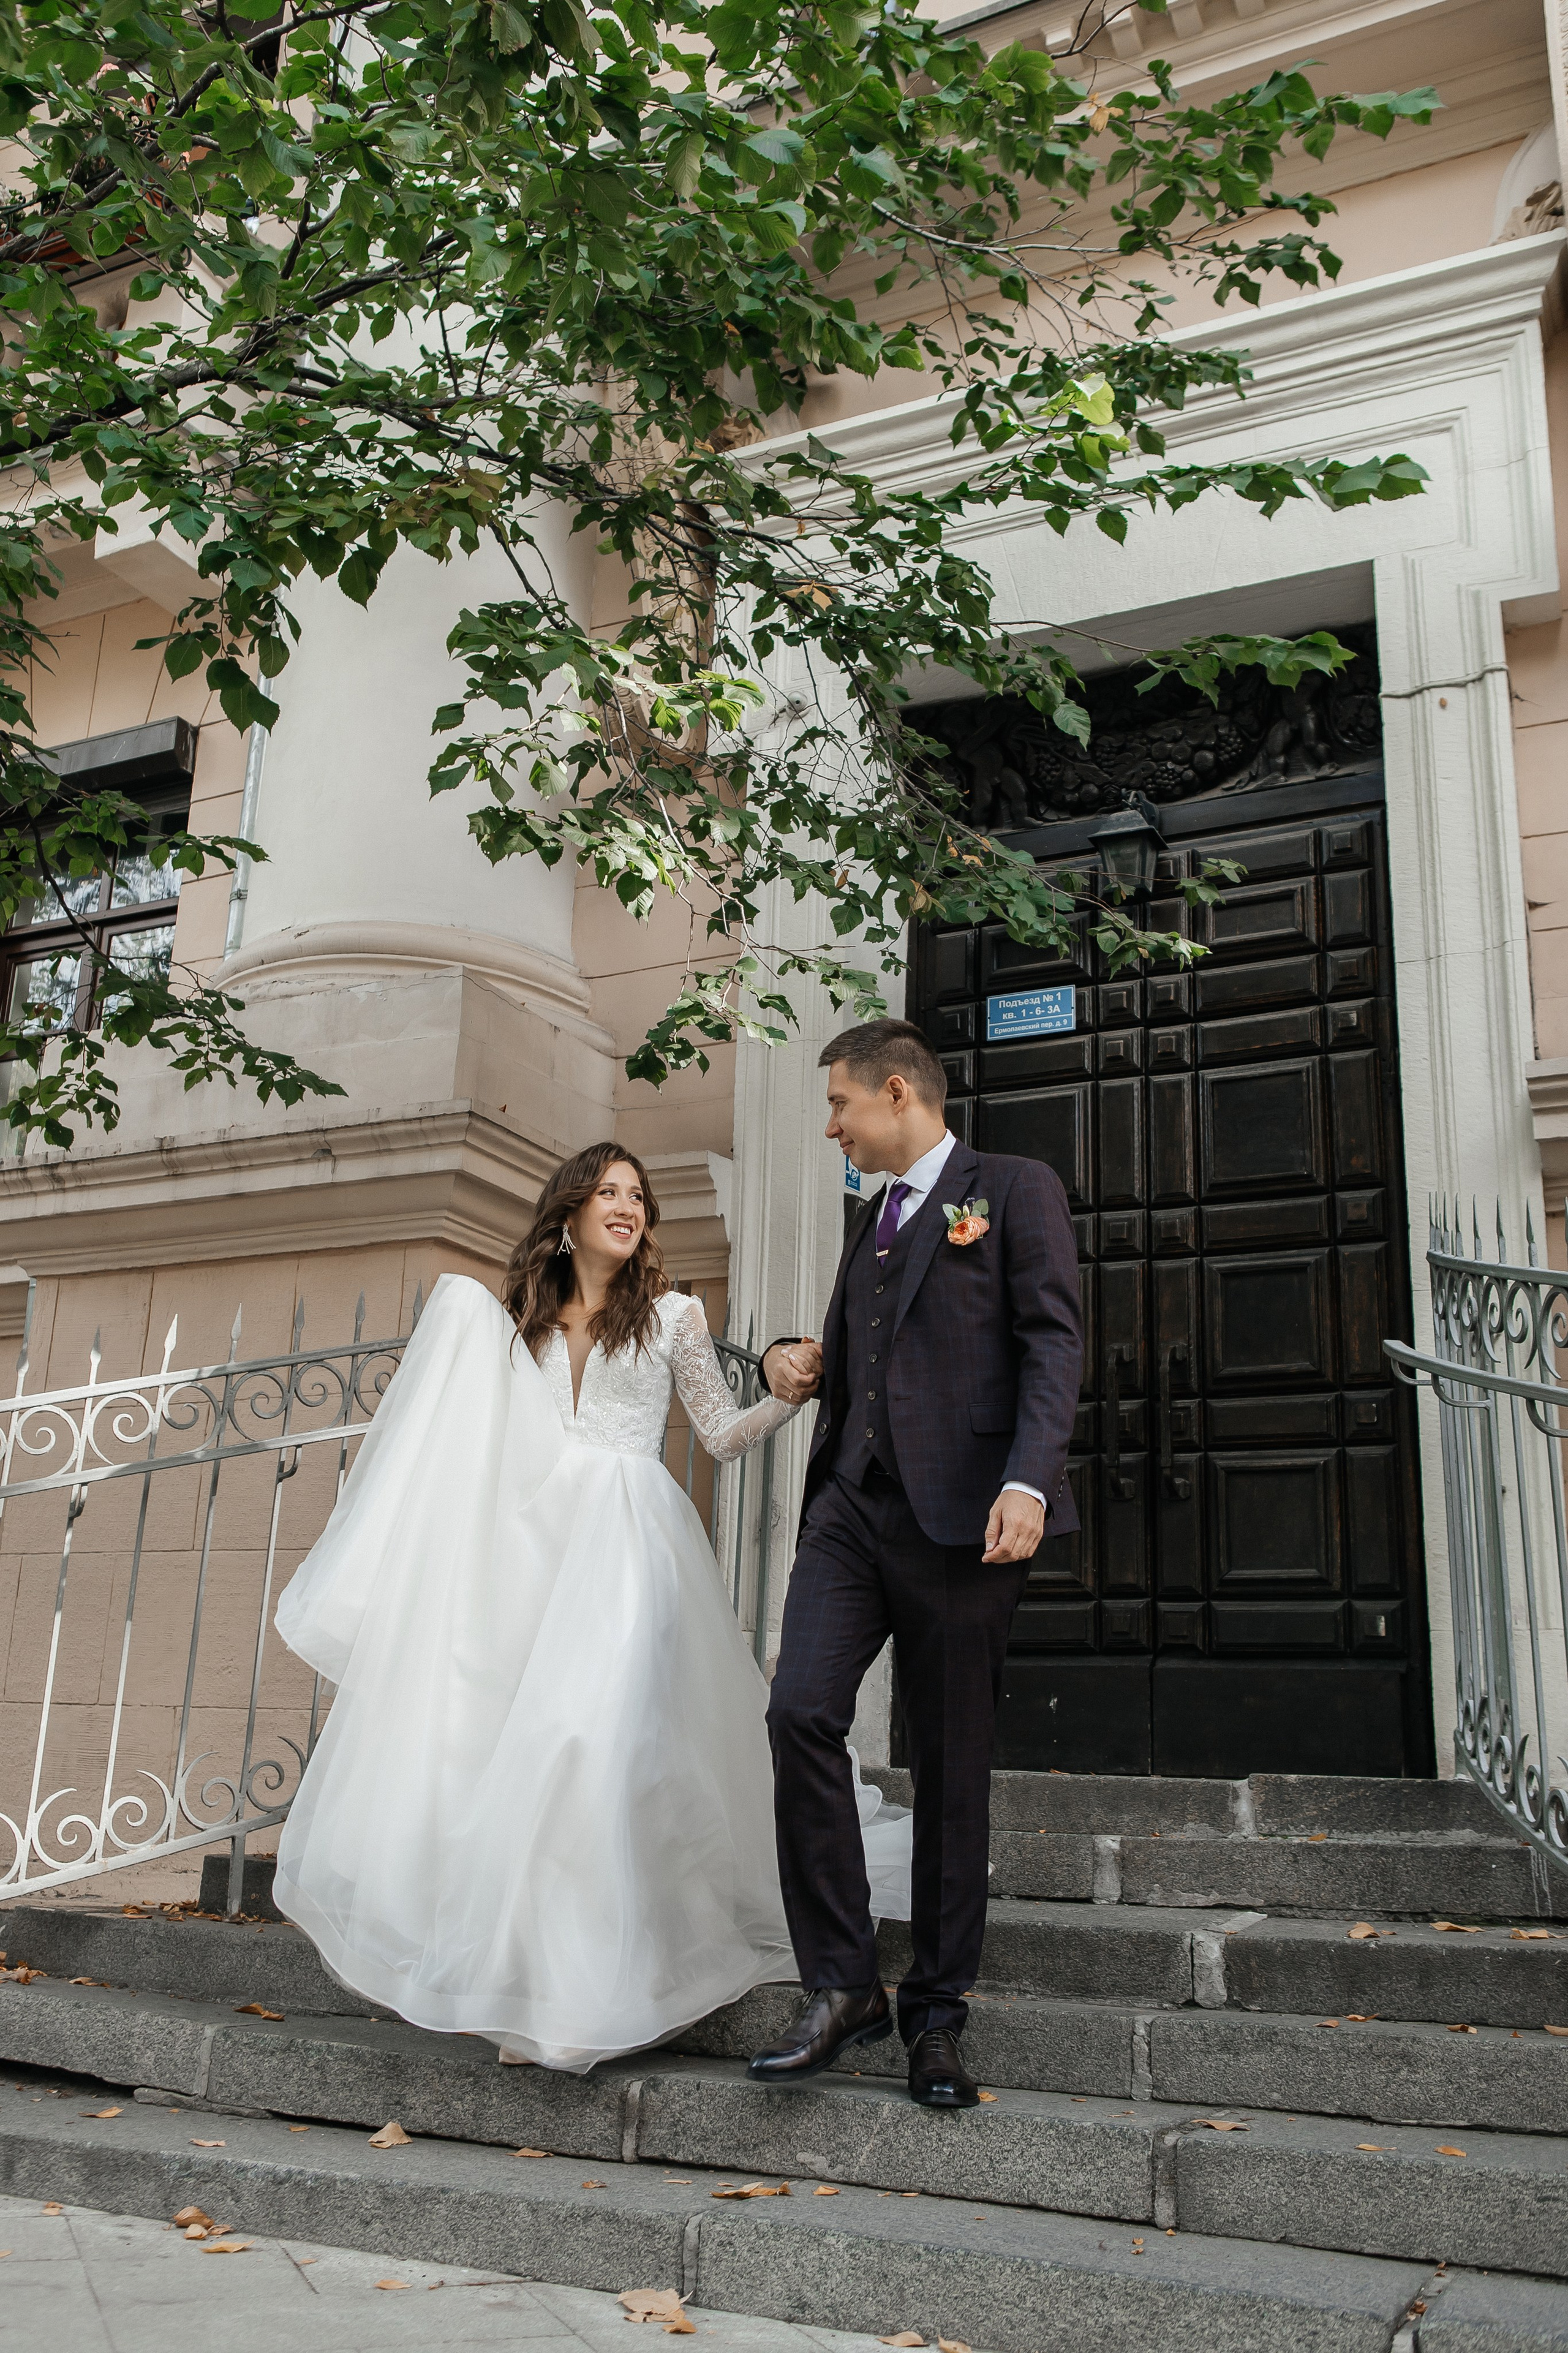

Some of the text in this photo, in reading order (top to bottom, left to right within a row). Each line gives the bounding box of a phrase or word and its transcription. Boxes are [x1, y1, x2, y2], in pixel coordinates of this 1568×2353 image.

[998, 997, 1041, 1008] Подъезд
[1056, 992, 1061, 1001] 1
[994, 1022, 1040, 1035] Ермолаевский
